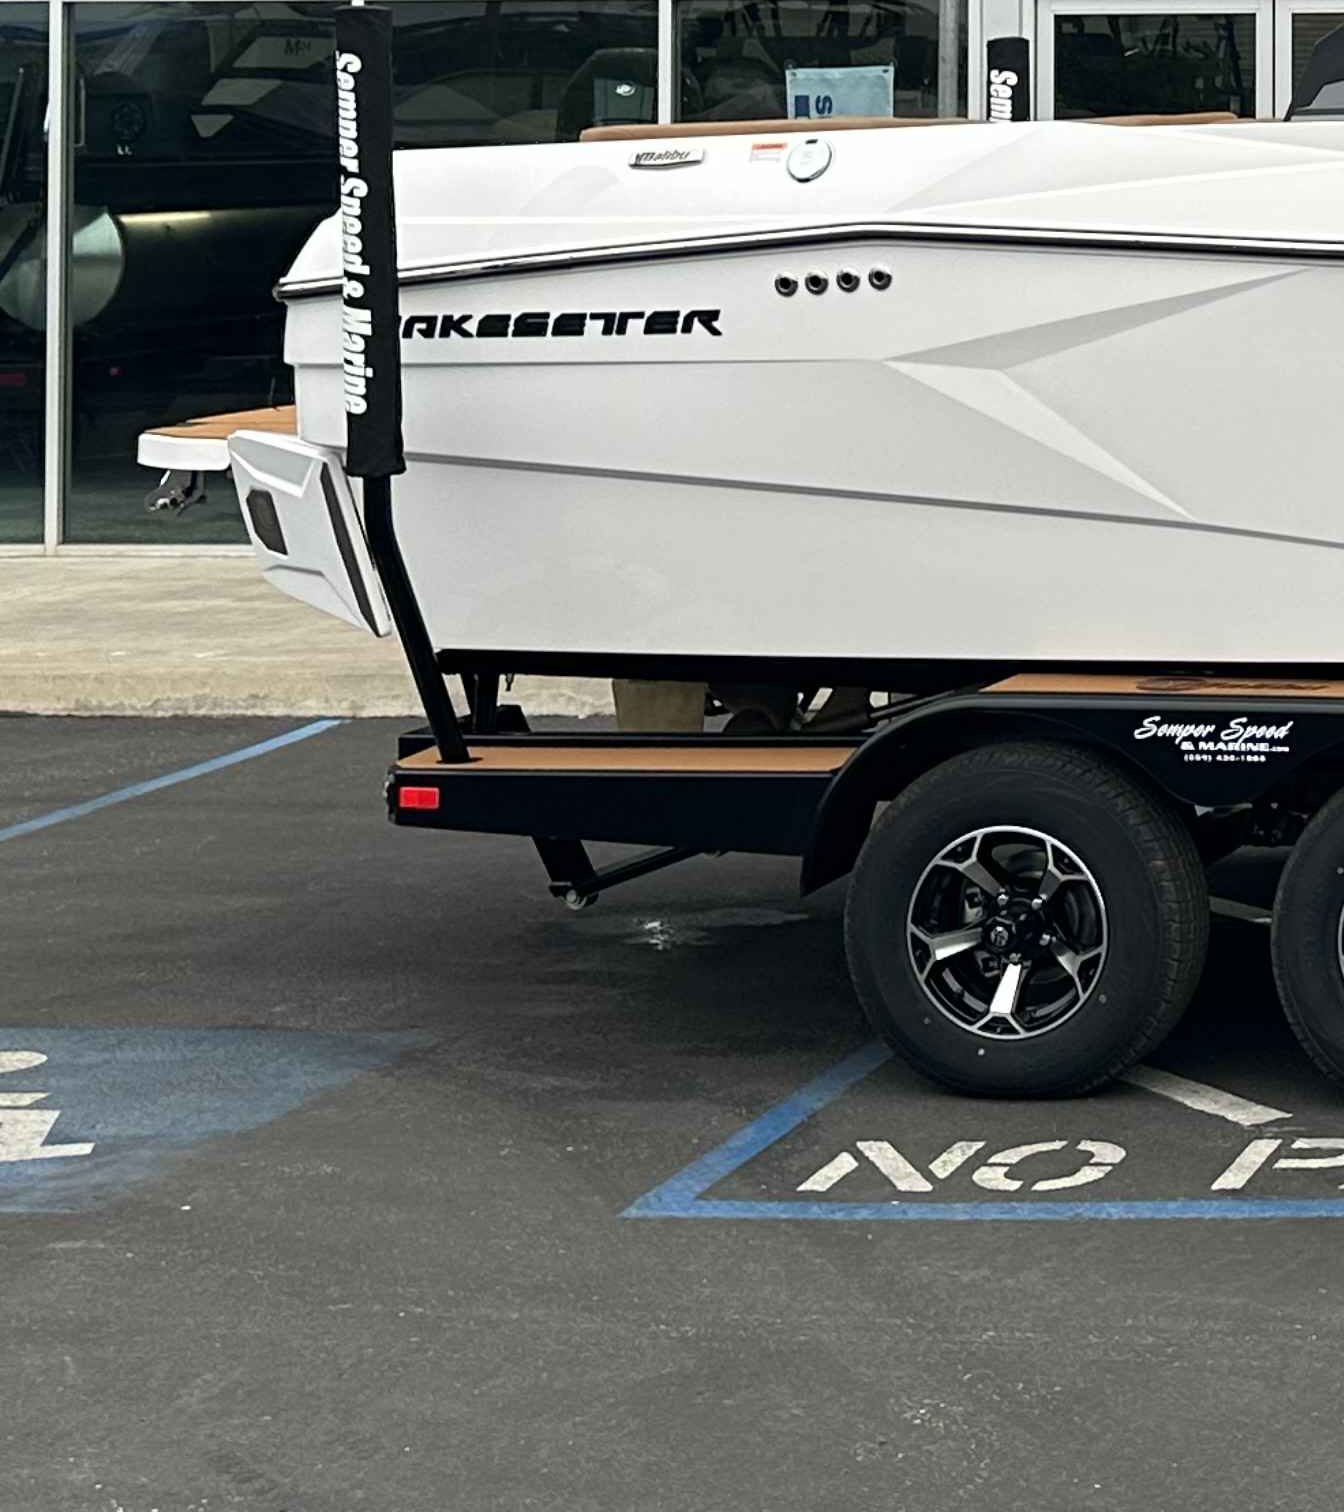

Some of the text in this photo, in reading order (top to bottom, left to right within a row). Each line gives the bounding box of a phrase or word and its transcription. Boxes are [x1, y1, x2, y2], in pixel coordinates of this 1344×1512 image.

[396, 309, 723, 339] AKESETTER
[1133, 715, 1294, 746] Semper Speed
[796, 1139, 1127, 1192] NO
